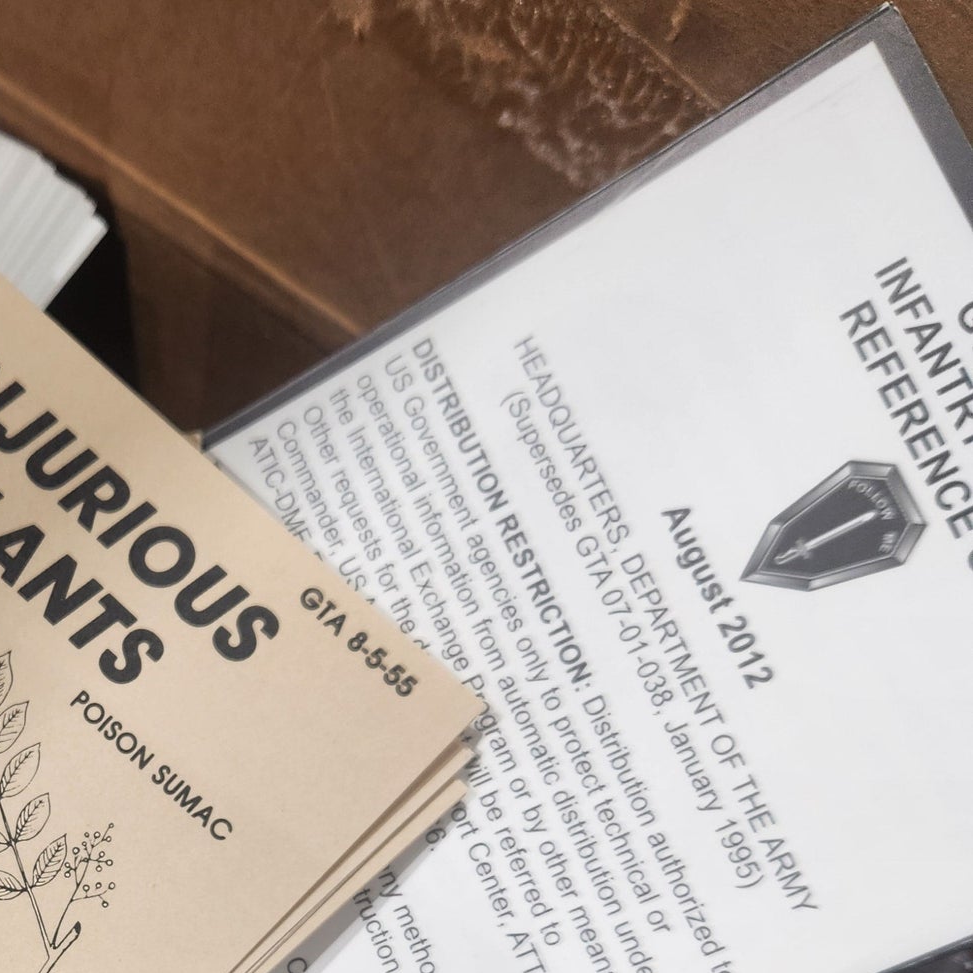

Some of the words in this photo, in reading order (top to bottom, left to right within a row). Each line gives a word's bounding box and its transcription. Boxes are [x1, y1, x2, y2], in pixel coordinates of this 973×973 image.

[384, 354, 414, 394] US
[839, 299, 973, 539] REFERENCE
[874, 256, 973, 446] INFANTR
[276, 420, 344, 557] Commander,
[303, 405, 340, 465] Other
[331, 468, 383, 562] requests
[374, 562, 400, 593] for
[390, 596, 416, 635] the
[403, 395, 480, 531] Government
[300, 587, 347, 637] GTA
[347, 631, 418, 697] 8-5-55
[329, 388, 354, 426] the
[346, 425, 423, 560] International
[409, 560, 470, 672] Exchange
[509, 777, 532, 799] or
[522, 803, 548, 833] by
[538, 840, 579, 898] other
[356, 373, 427, 493] operational
[413, 492, 480, 617] information
[471, 617, 506, 672] from
[497, 676, 560, 786] automatic
[552, 790, 623, 916] distribution
[411, 337, 509, 512] DISTRIBUTION
[495, 513, 593, 692] RESTRICTION:
[582, 694, 656, 827] Distribution
[647, 832, 726, 957] authorized
[466, 533, 524, 633] agencies
[499, 390, 583, 533] (Supersedes
[576, 535, 614, 590] GTA
[601, 589, 674, 716] 07-01-038,
[663, 722, 724, 811] January
[715, 818, 765, 889] 1995)
[514, 335, 630, 554] HEADQUARTERS,
[620, 552, 725, 726] DEPARTMENT
[710, 734, 746, 769] OF
[732, 774, 776, 833] THE
[758, 838, 819, 910] ARMY
[661, 507, 735, 615] August
[717, 615, 774, 690] 2012
[516, 637, 549, 682] only
[540, 686, 562, 712] to
[69, 689, 155, 771] POISON
[151, 764, 233, 841] SUMAC
[547, 715, 607, 796] protect
[468, 842, 515, 928] Center,
[479, 789, 503, 822] be
[494, 826, 554, 918] referred
[540, 921, 561, 946] to
[593, 798, 661, 904] technical
[646, 910, 671, 932] or
